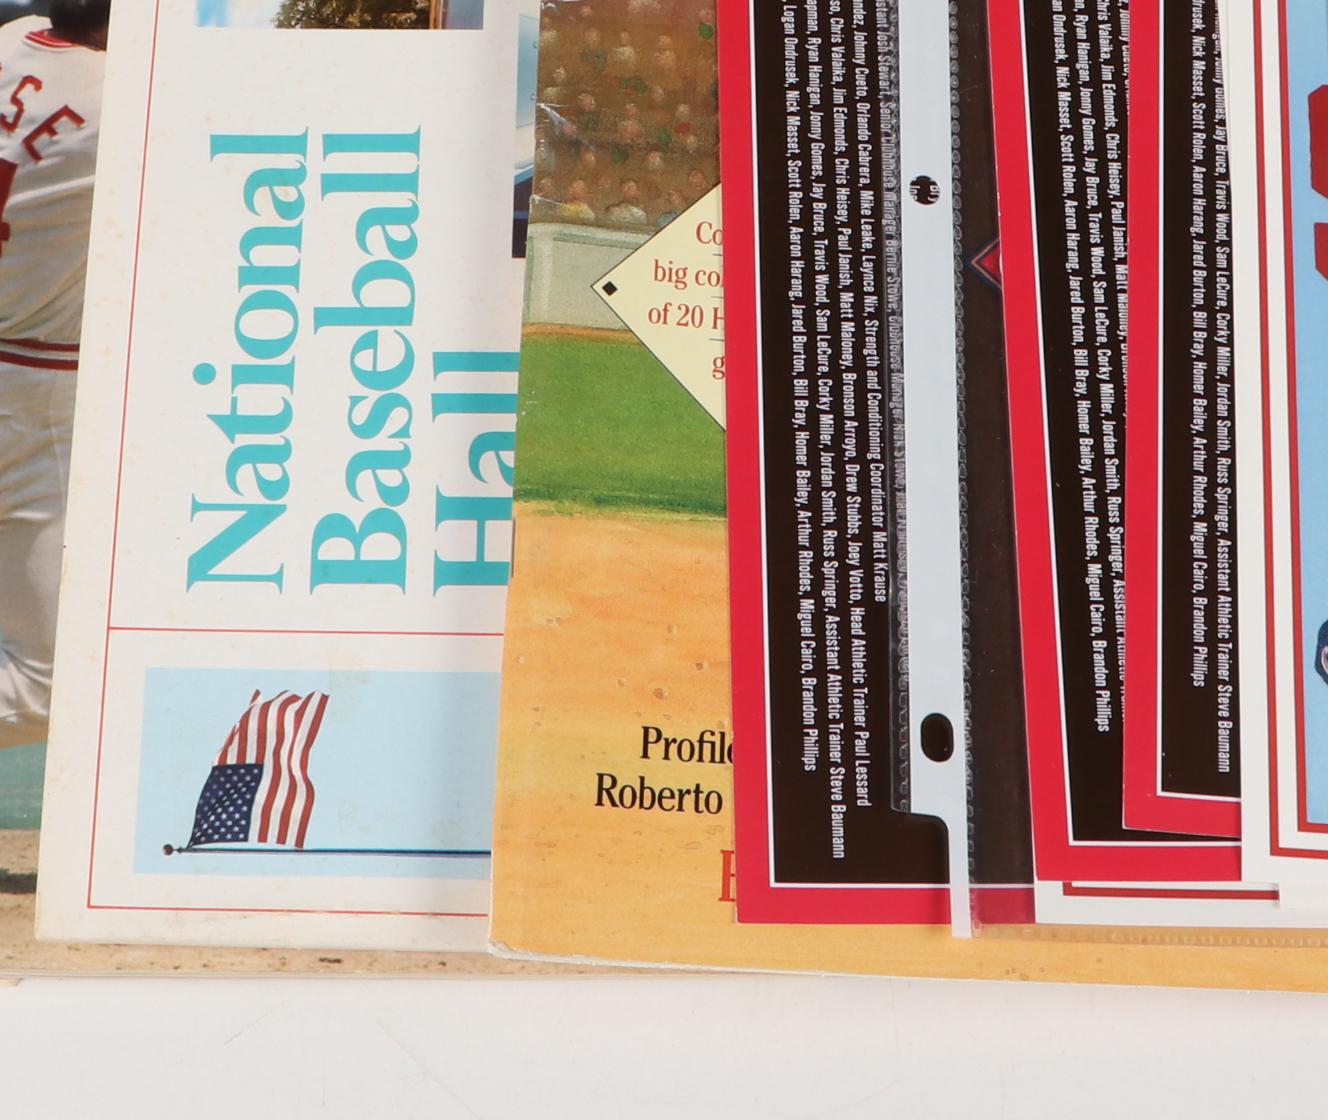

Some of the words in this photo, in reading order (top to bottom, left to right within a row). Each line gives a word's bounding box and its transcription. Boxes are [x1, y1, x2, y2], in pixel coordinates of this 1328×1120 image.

[654, 259, 688, 291] big
[648, 302, 672, 325] of
[676, 303, 704, 328] 20
[186, 126, 308, 594] National
[310, 124, 421, 595] Baseball
[432, 351, 520, 597] Hall
[802, 677, 818, 725] Brandon
[801, 728, 819, 771] Phillips
[594, 772, 723, 814] Roberto
